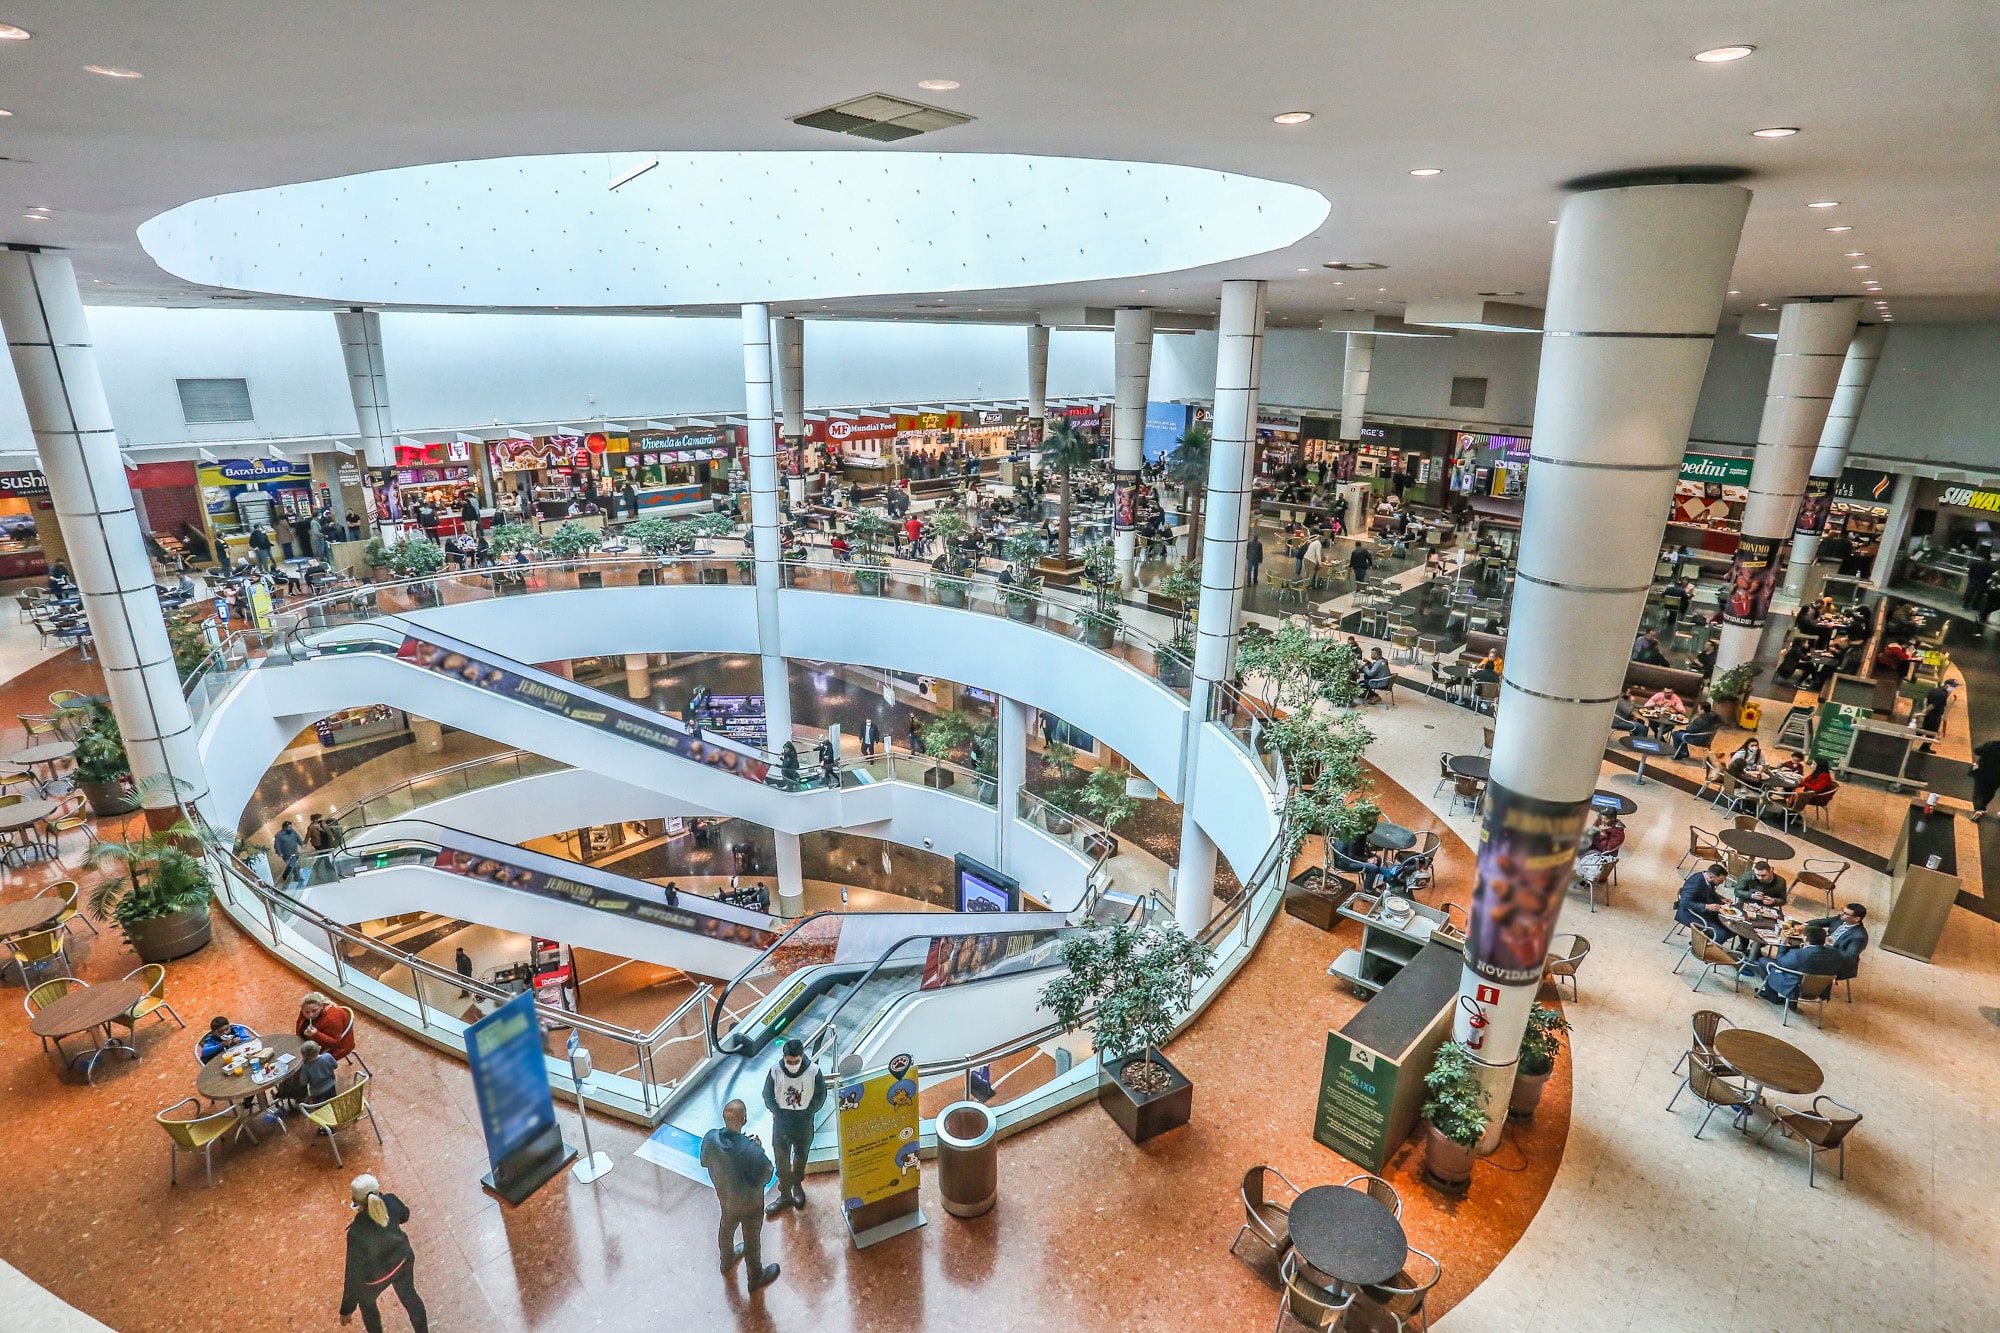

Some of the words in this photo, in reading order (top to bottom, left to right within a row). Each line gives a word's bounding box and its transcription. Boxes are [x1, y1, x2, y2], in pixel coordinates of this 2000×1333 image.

[832, 425, 848, 436] MF
[850, 424, 879, 432] Mundial
[880, 422, 896, 430] Food
[641, 437, 674, 449] Vivenda
[682, 434, 716, 446] Camarão
[225, 466, 289, 477] BATATOUILLE
[515, 680, 568, 705] JERONIMO
[544, 877, 593, 897] JERONIMO
